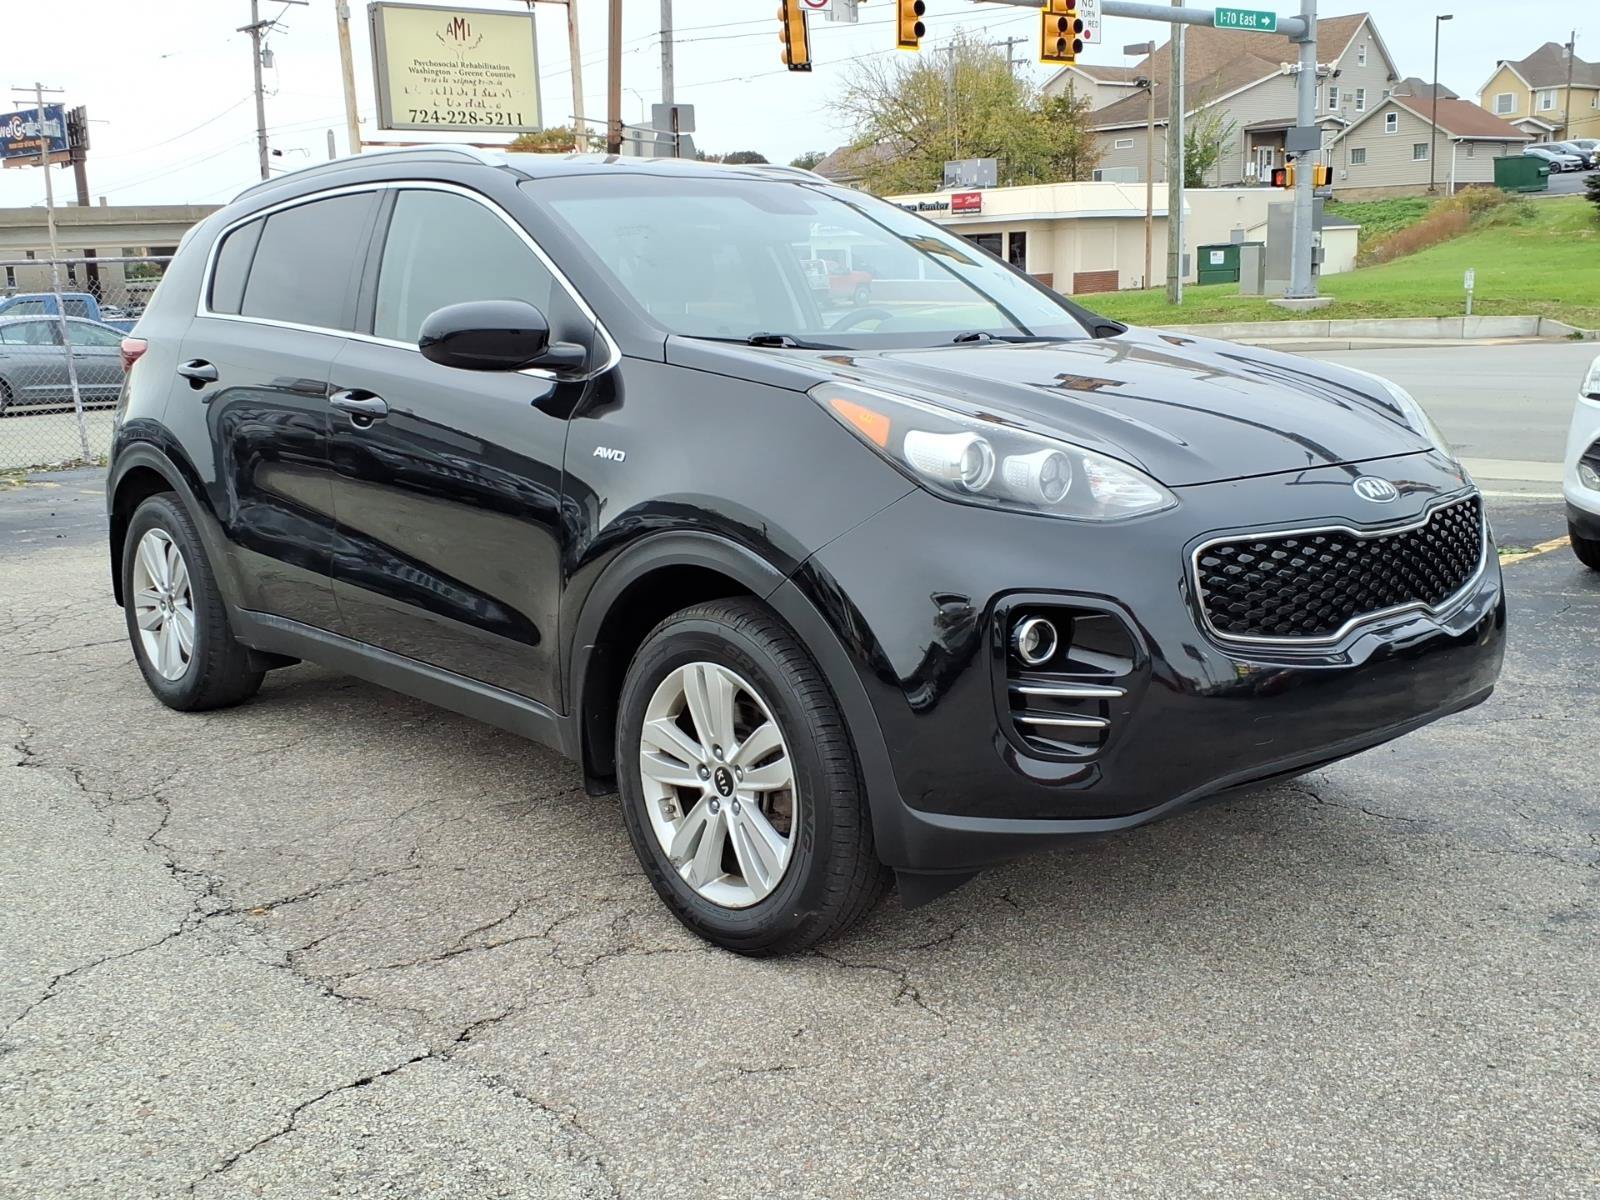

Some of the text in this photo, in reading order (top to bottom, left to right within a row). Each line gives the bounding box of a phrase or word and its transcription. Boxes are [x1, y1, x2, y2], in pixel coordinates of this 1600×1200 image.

[1220, 12, 1257, 26] I-70 East
[446, 17, 471, 41] AMI
[408, 66, 451, 76] Washington
[458, 69, 483, 77] Greene
[485, 70, 516, 79] Counties
[413, 59, 511, 71] Psychosocial Rehabilitation
[408, 108, 524, 126] 724-228-5211
[918, 201, 950, 212] Center
[593, 446, 626, 462] AWD
[1358, 480, 1395, 498] KIA
[716, 769, 729, 796] KIA
